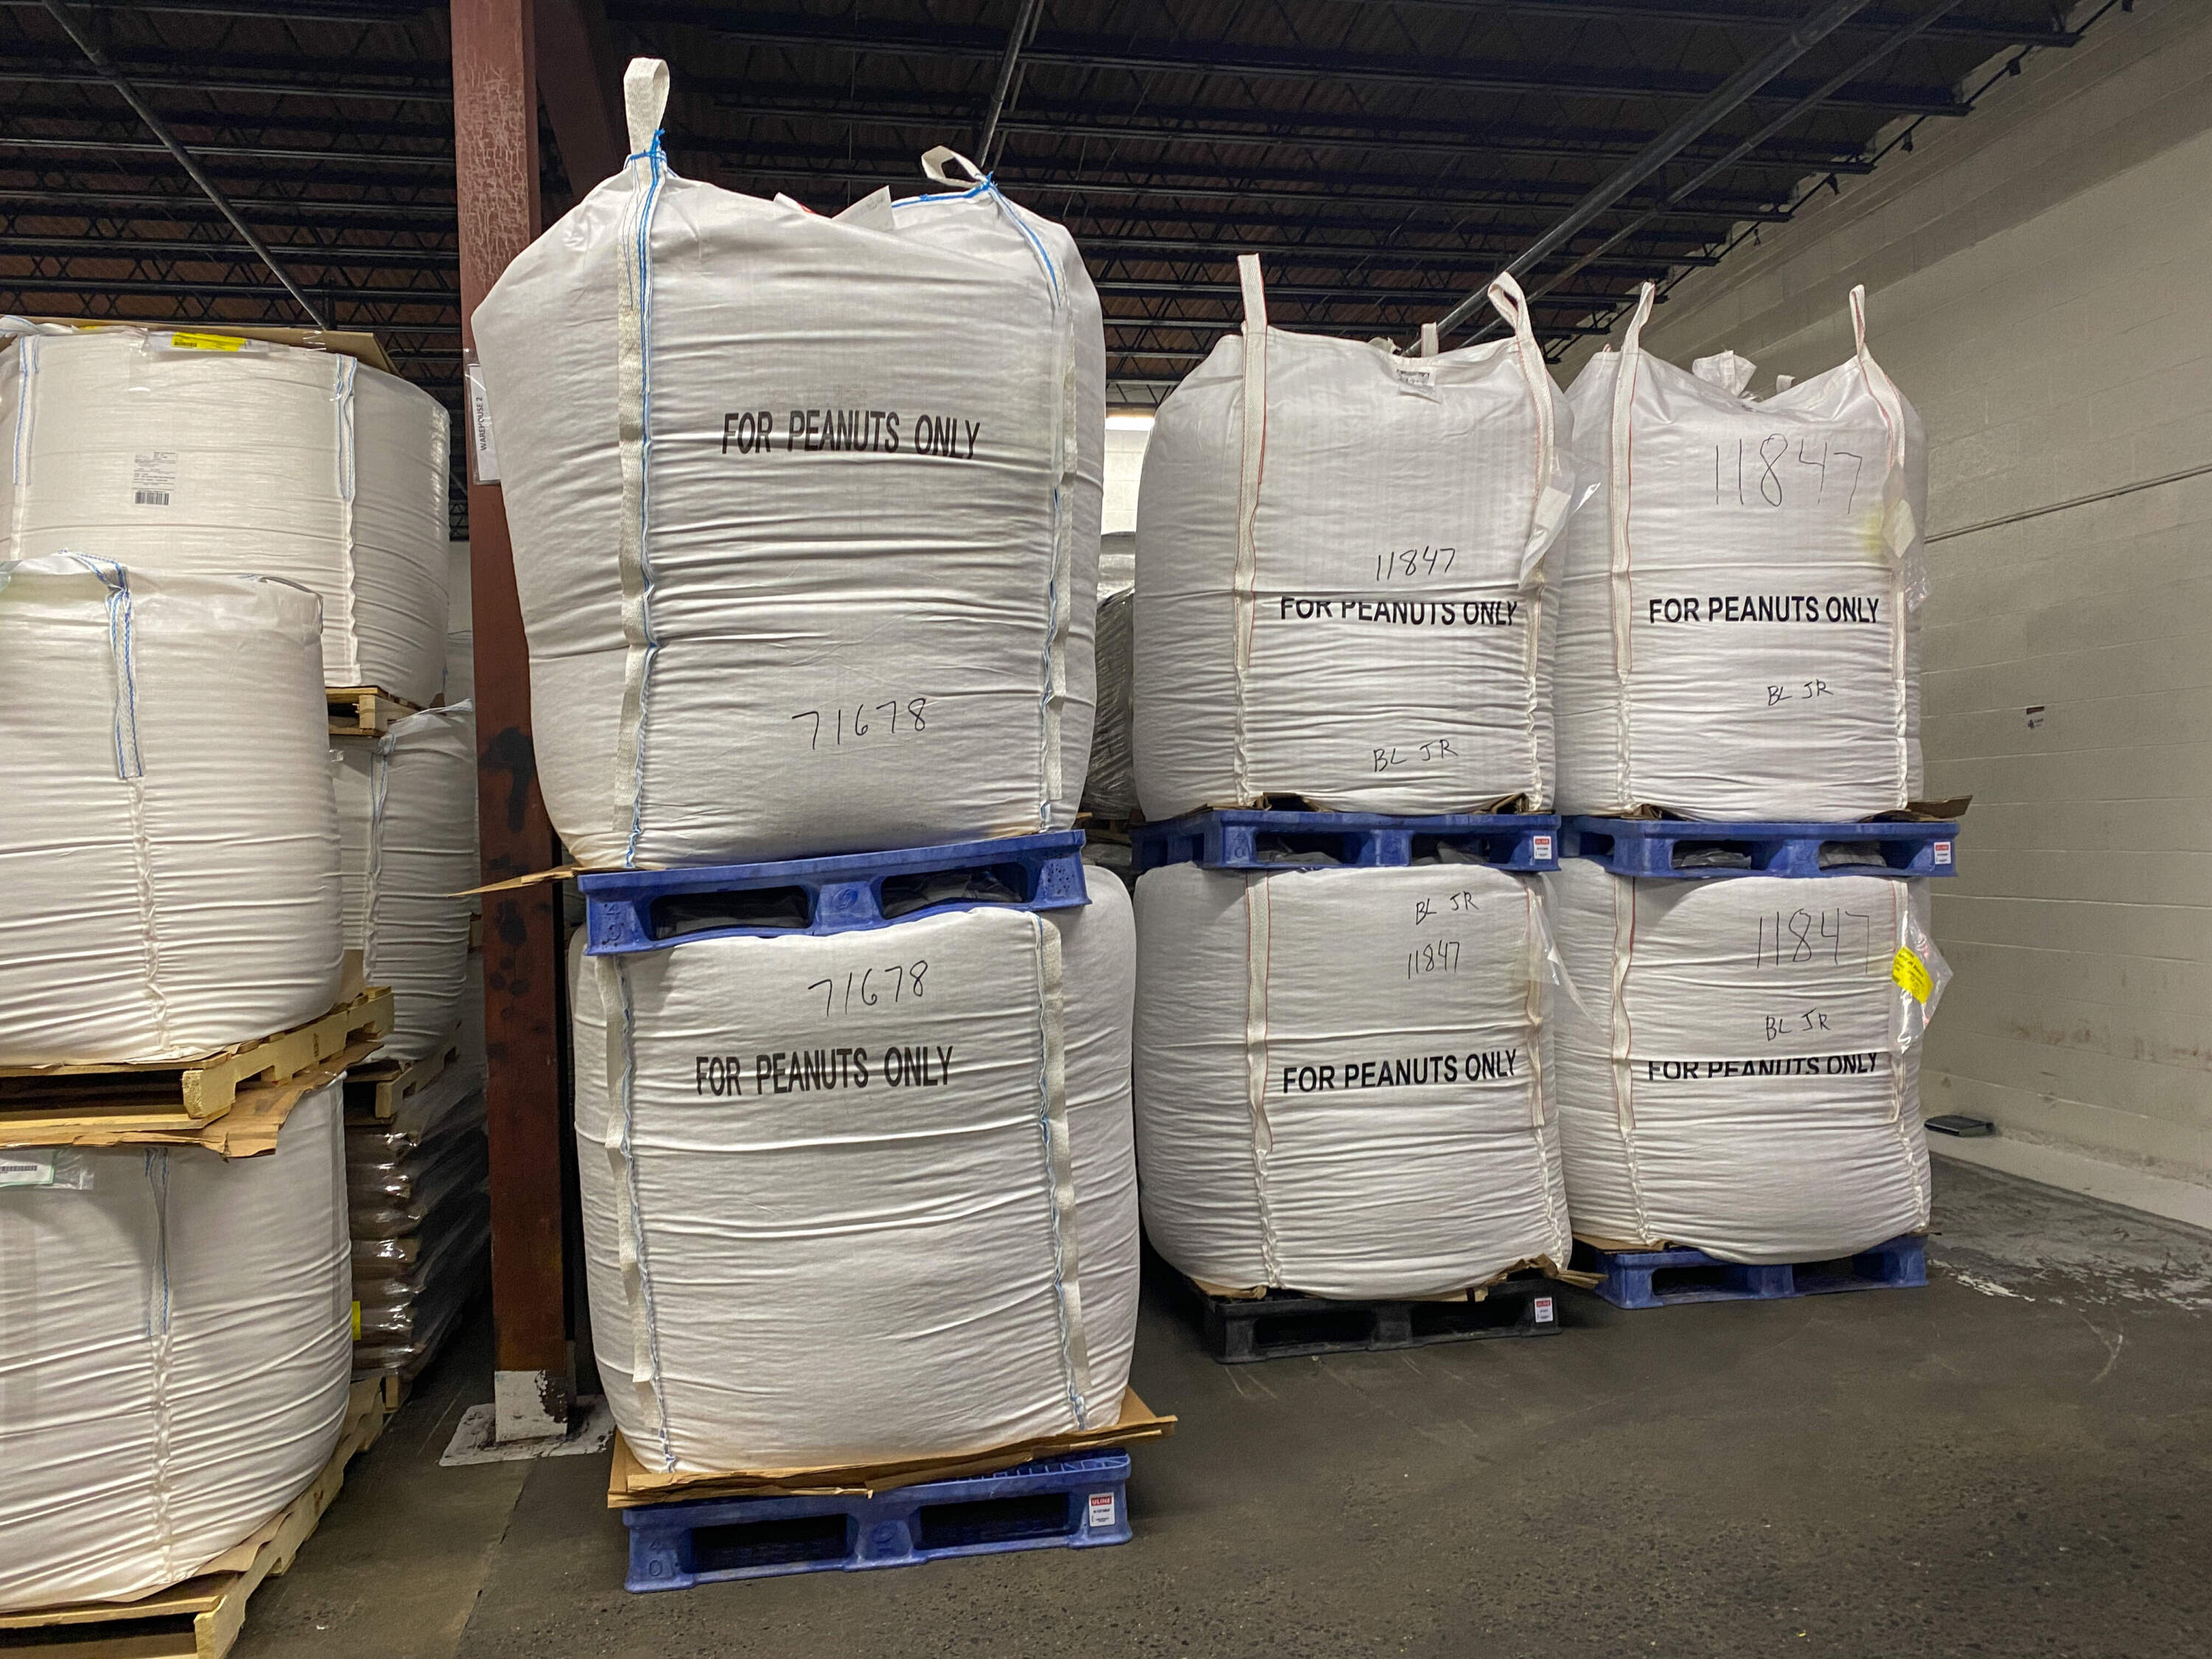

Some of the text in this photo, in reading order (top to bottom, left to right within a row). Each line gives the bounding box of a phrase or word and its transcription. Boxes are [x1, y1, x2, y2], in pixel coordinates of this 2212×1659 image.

[721, 408, 981, 460] FOR PEANUTS ONLY
[1716, 434, 1863, 515] 11847
[1376, 545, 1455, 582] 11847
[1280, 596, 1517, 626] FOR PEANUTS ONLY
[1649, 595, 1879, 624] FOR PEANUTS ONLY
[1767, 679, 1834, 706] BL JR
[791, 698, 928, 751] 71678
[1373, 739, 1459, 773] BL JR
[1415, 890, 1479, 926] BL JR
[1408, 939, 1460, 980] 11847
[1756, 908, 1870, 975] 11847
[807, 959, 928, 1018] 71678
[1765, 1008, 1830, 1042] BL JR
[695, 1046, 953, 1096] FOR PEANUTS ONLY
[1282, 1048, 1517, 1093] FOR PEANUTS ONLY
[1648, 1051, 1878, 1082] FOR PEANUTS ONLY
[1091, 1497, 1111, 1506] ULINE
